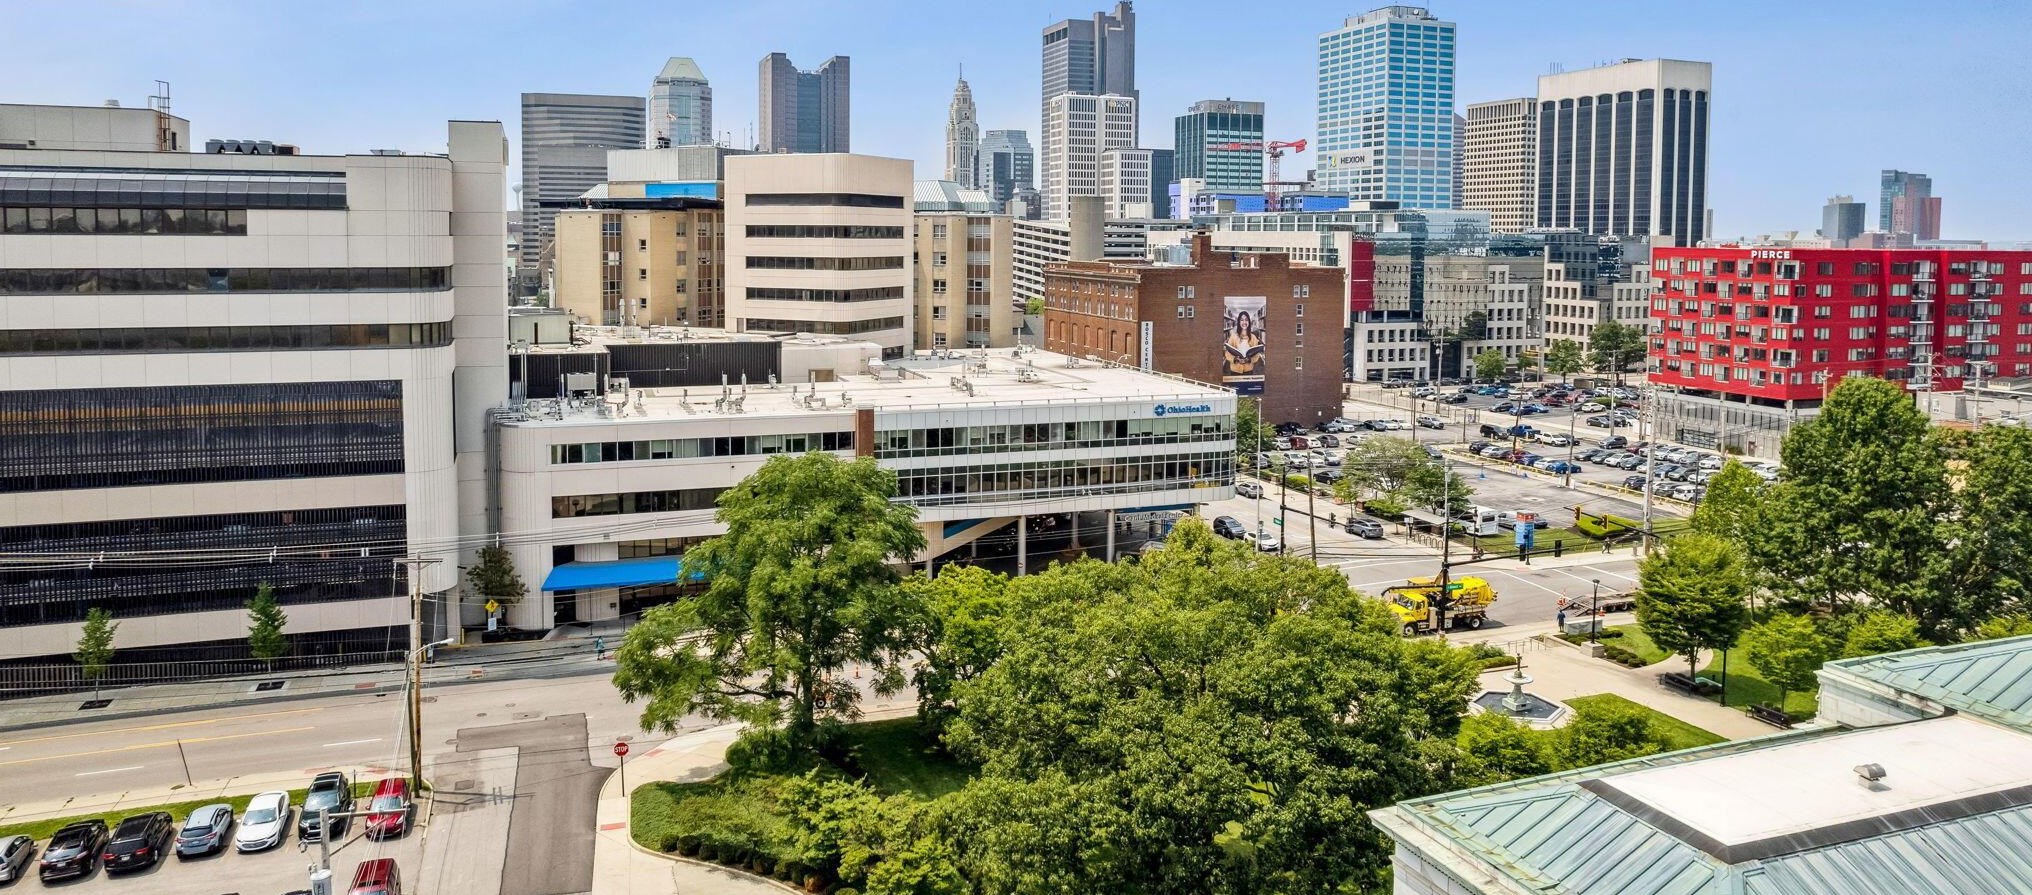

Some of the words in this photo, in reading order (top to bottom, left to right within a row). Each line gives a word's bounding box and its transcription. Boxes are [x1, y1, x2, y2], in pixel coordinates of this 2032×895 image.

[1340, 155, 1365, 164] HEXION
[1751, 250, 1790, 259] PIERCE
[1167, 404, 1211, 414] OhioHealth
[614, 745, 629, 753] STOP
